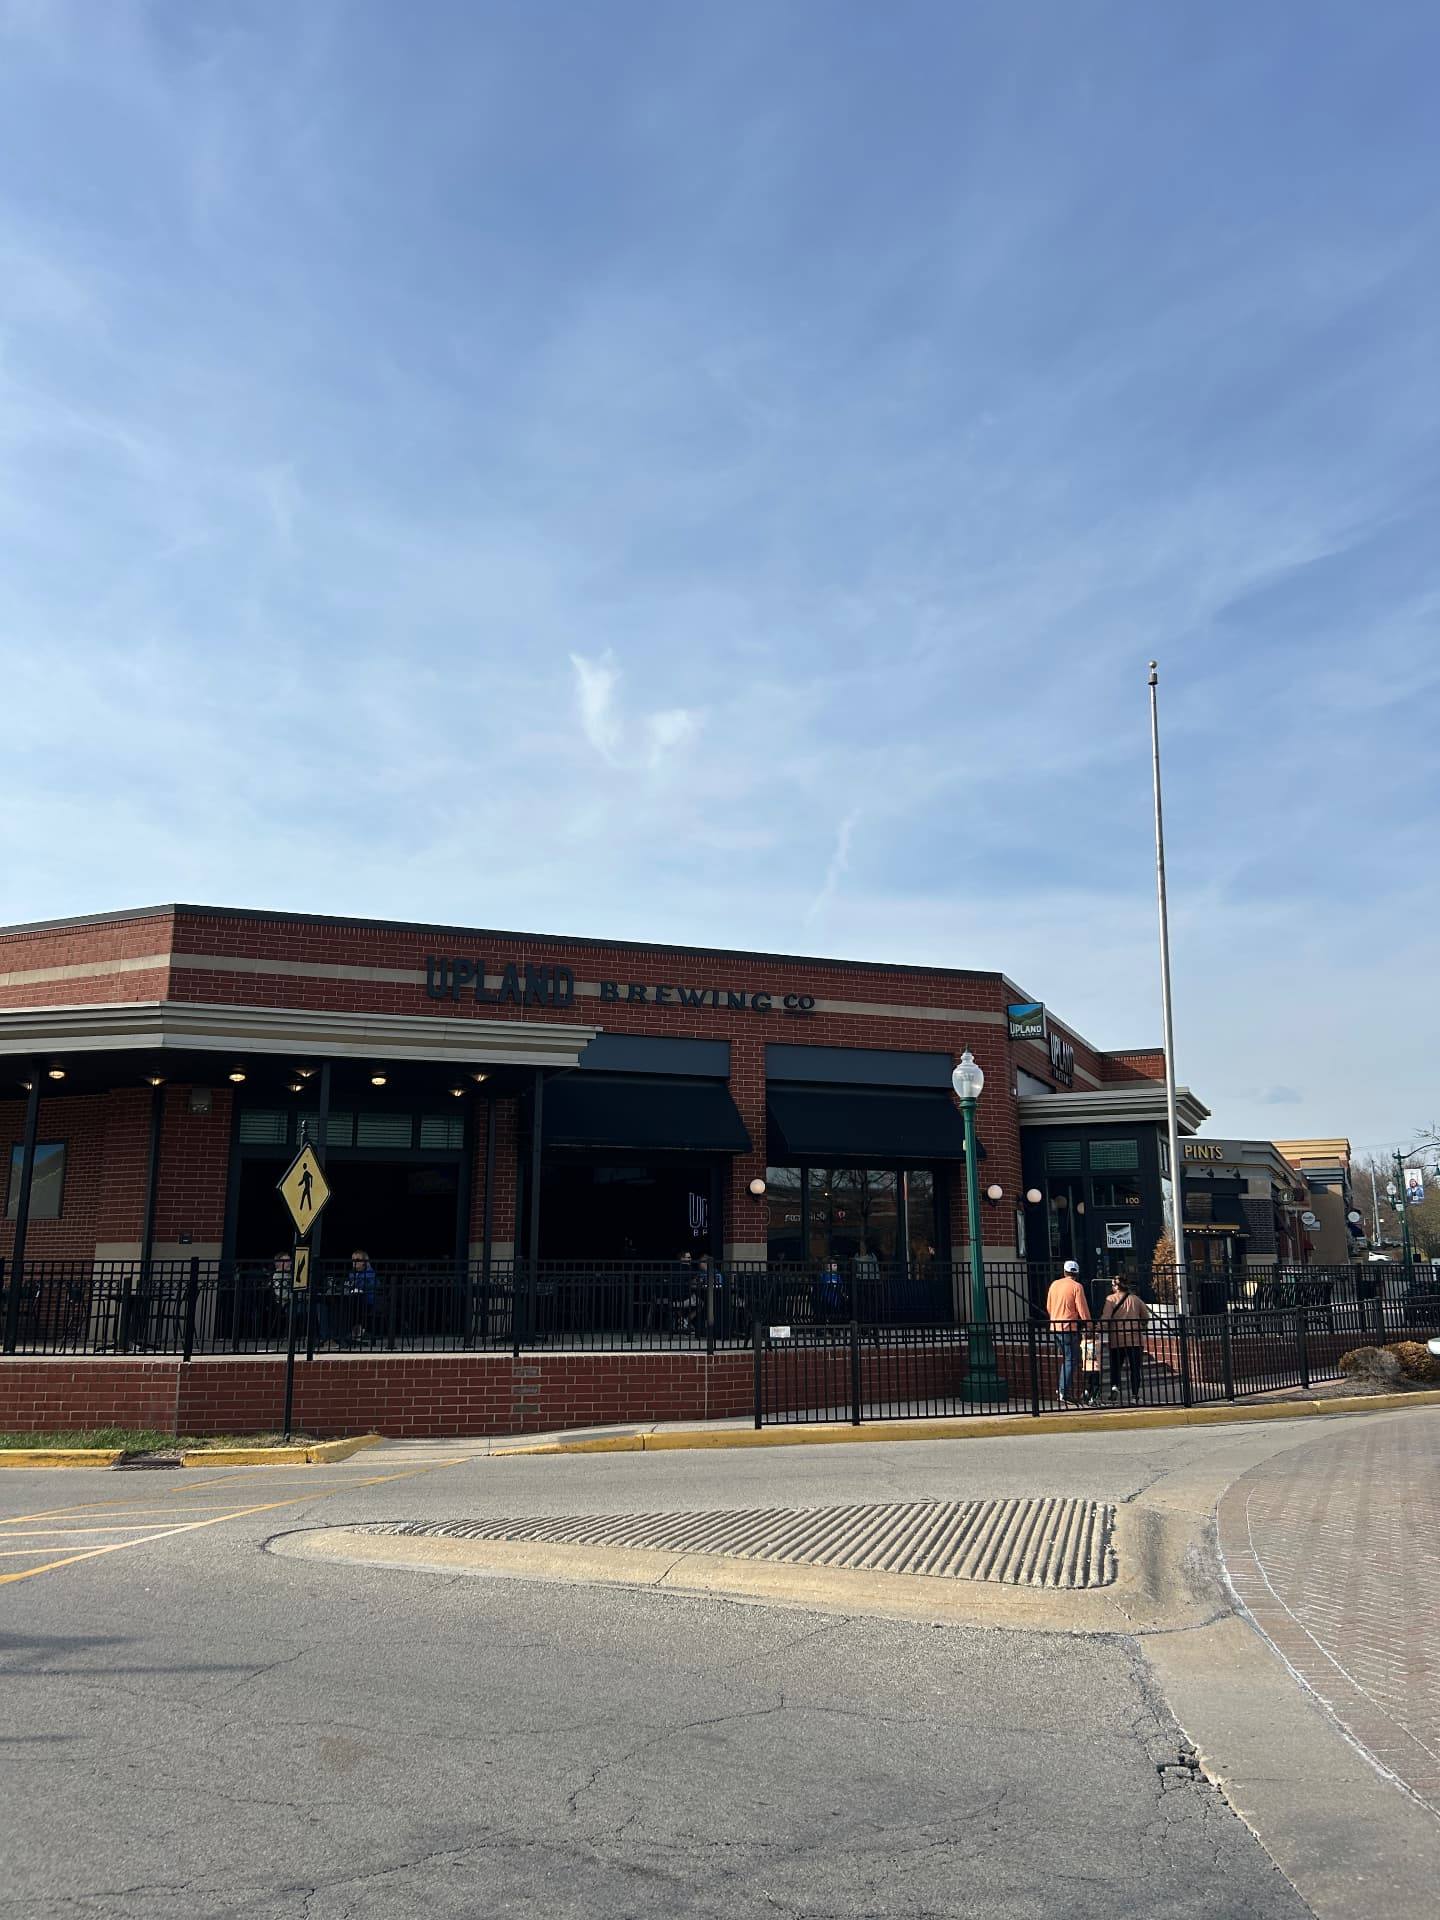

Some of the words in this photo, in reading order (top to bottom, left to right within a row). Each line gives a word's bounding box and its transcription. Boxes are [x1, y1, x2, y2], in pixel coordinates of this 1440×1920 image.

[427, 955, 575, 1008] UPLAND
[600, 981, 773, 1012] BREWING
[783, 993, 815, 1011] CO
[1010, 1022, 1042, 1034] UPLAND
[1050, 1032, 1074, 1073] UPLAND
[1184, 1144, 1224, 1160] PINTS
[1125, 1197, 1140, 1205] 100
[1108, 1236, 1131, 1245] UPLAND
